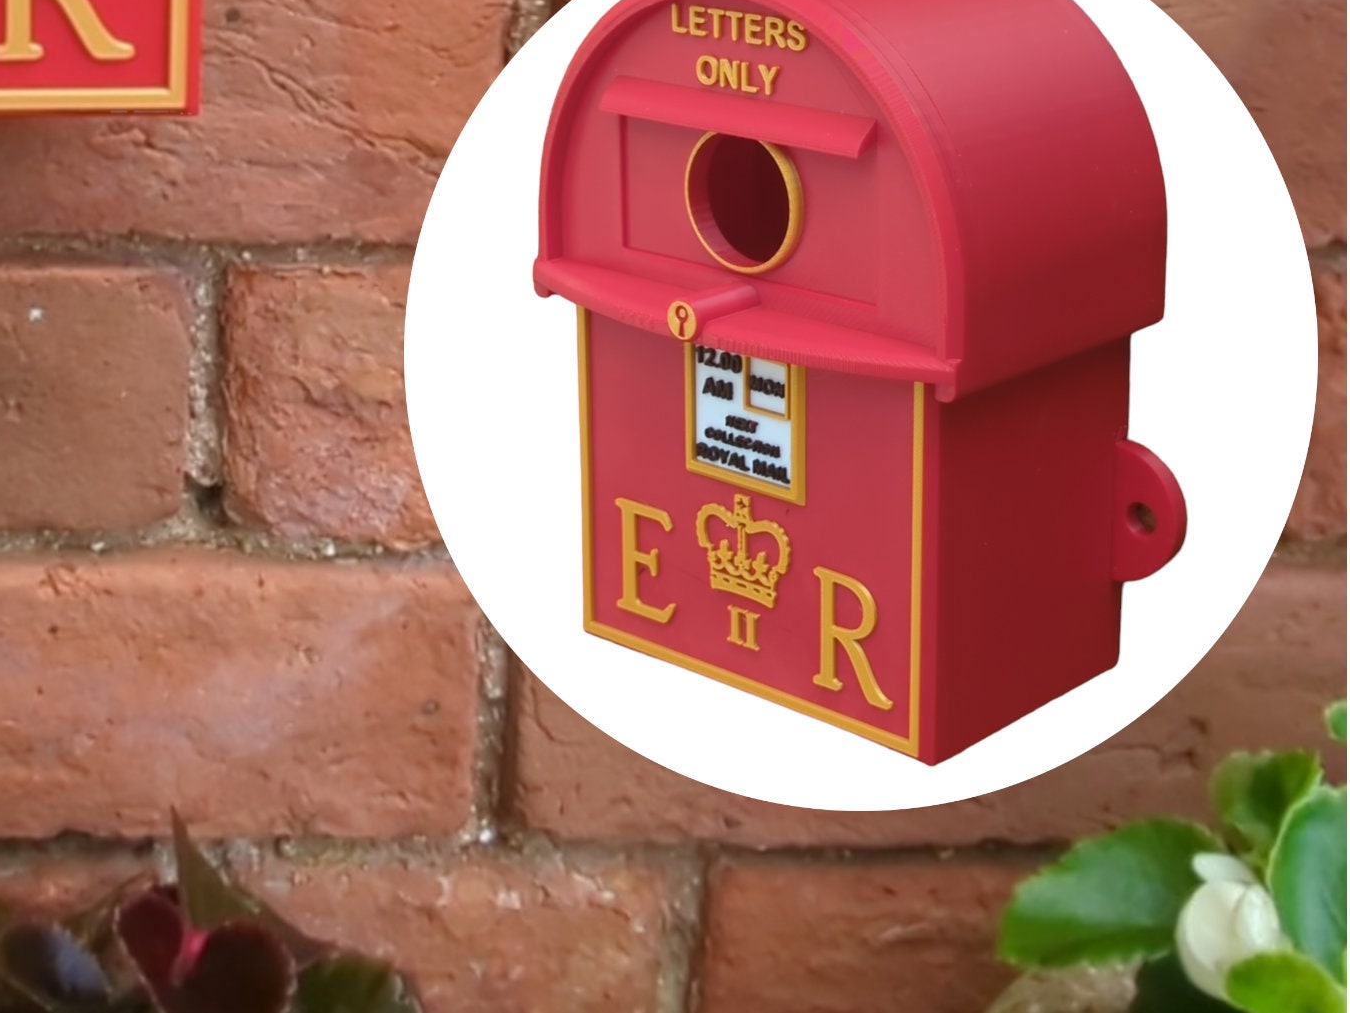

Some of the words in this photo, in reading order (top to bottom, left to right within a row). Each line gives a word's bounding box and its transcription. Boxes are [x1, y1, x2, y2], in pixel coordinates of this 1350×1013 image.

[671, 3, 807, 51] LETTERS
[696, 55, 780, 95] ONLY
[696, 345, 743, 374] 12.00
[702, 376, 734, 400] AM
[750, 375, 785, 399] MON
[696, 442, 749, 471] ROYAL
[752, 459, 790, 484] MAIL
[615, 497, 676, 624] E
[813, 566, 893, 710] R
[727, 605, 760, 651] II
